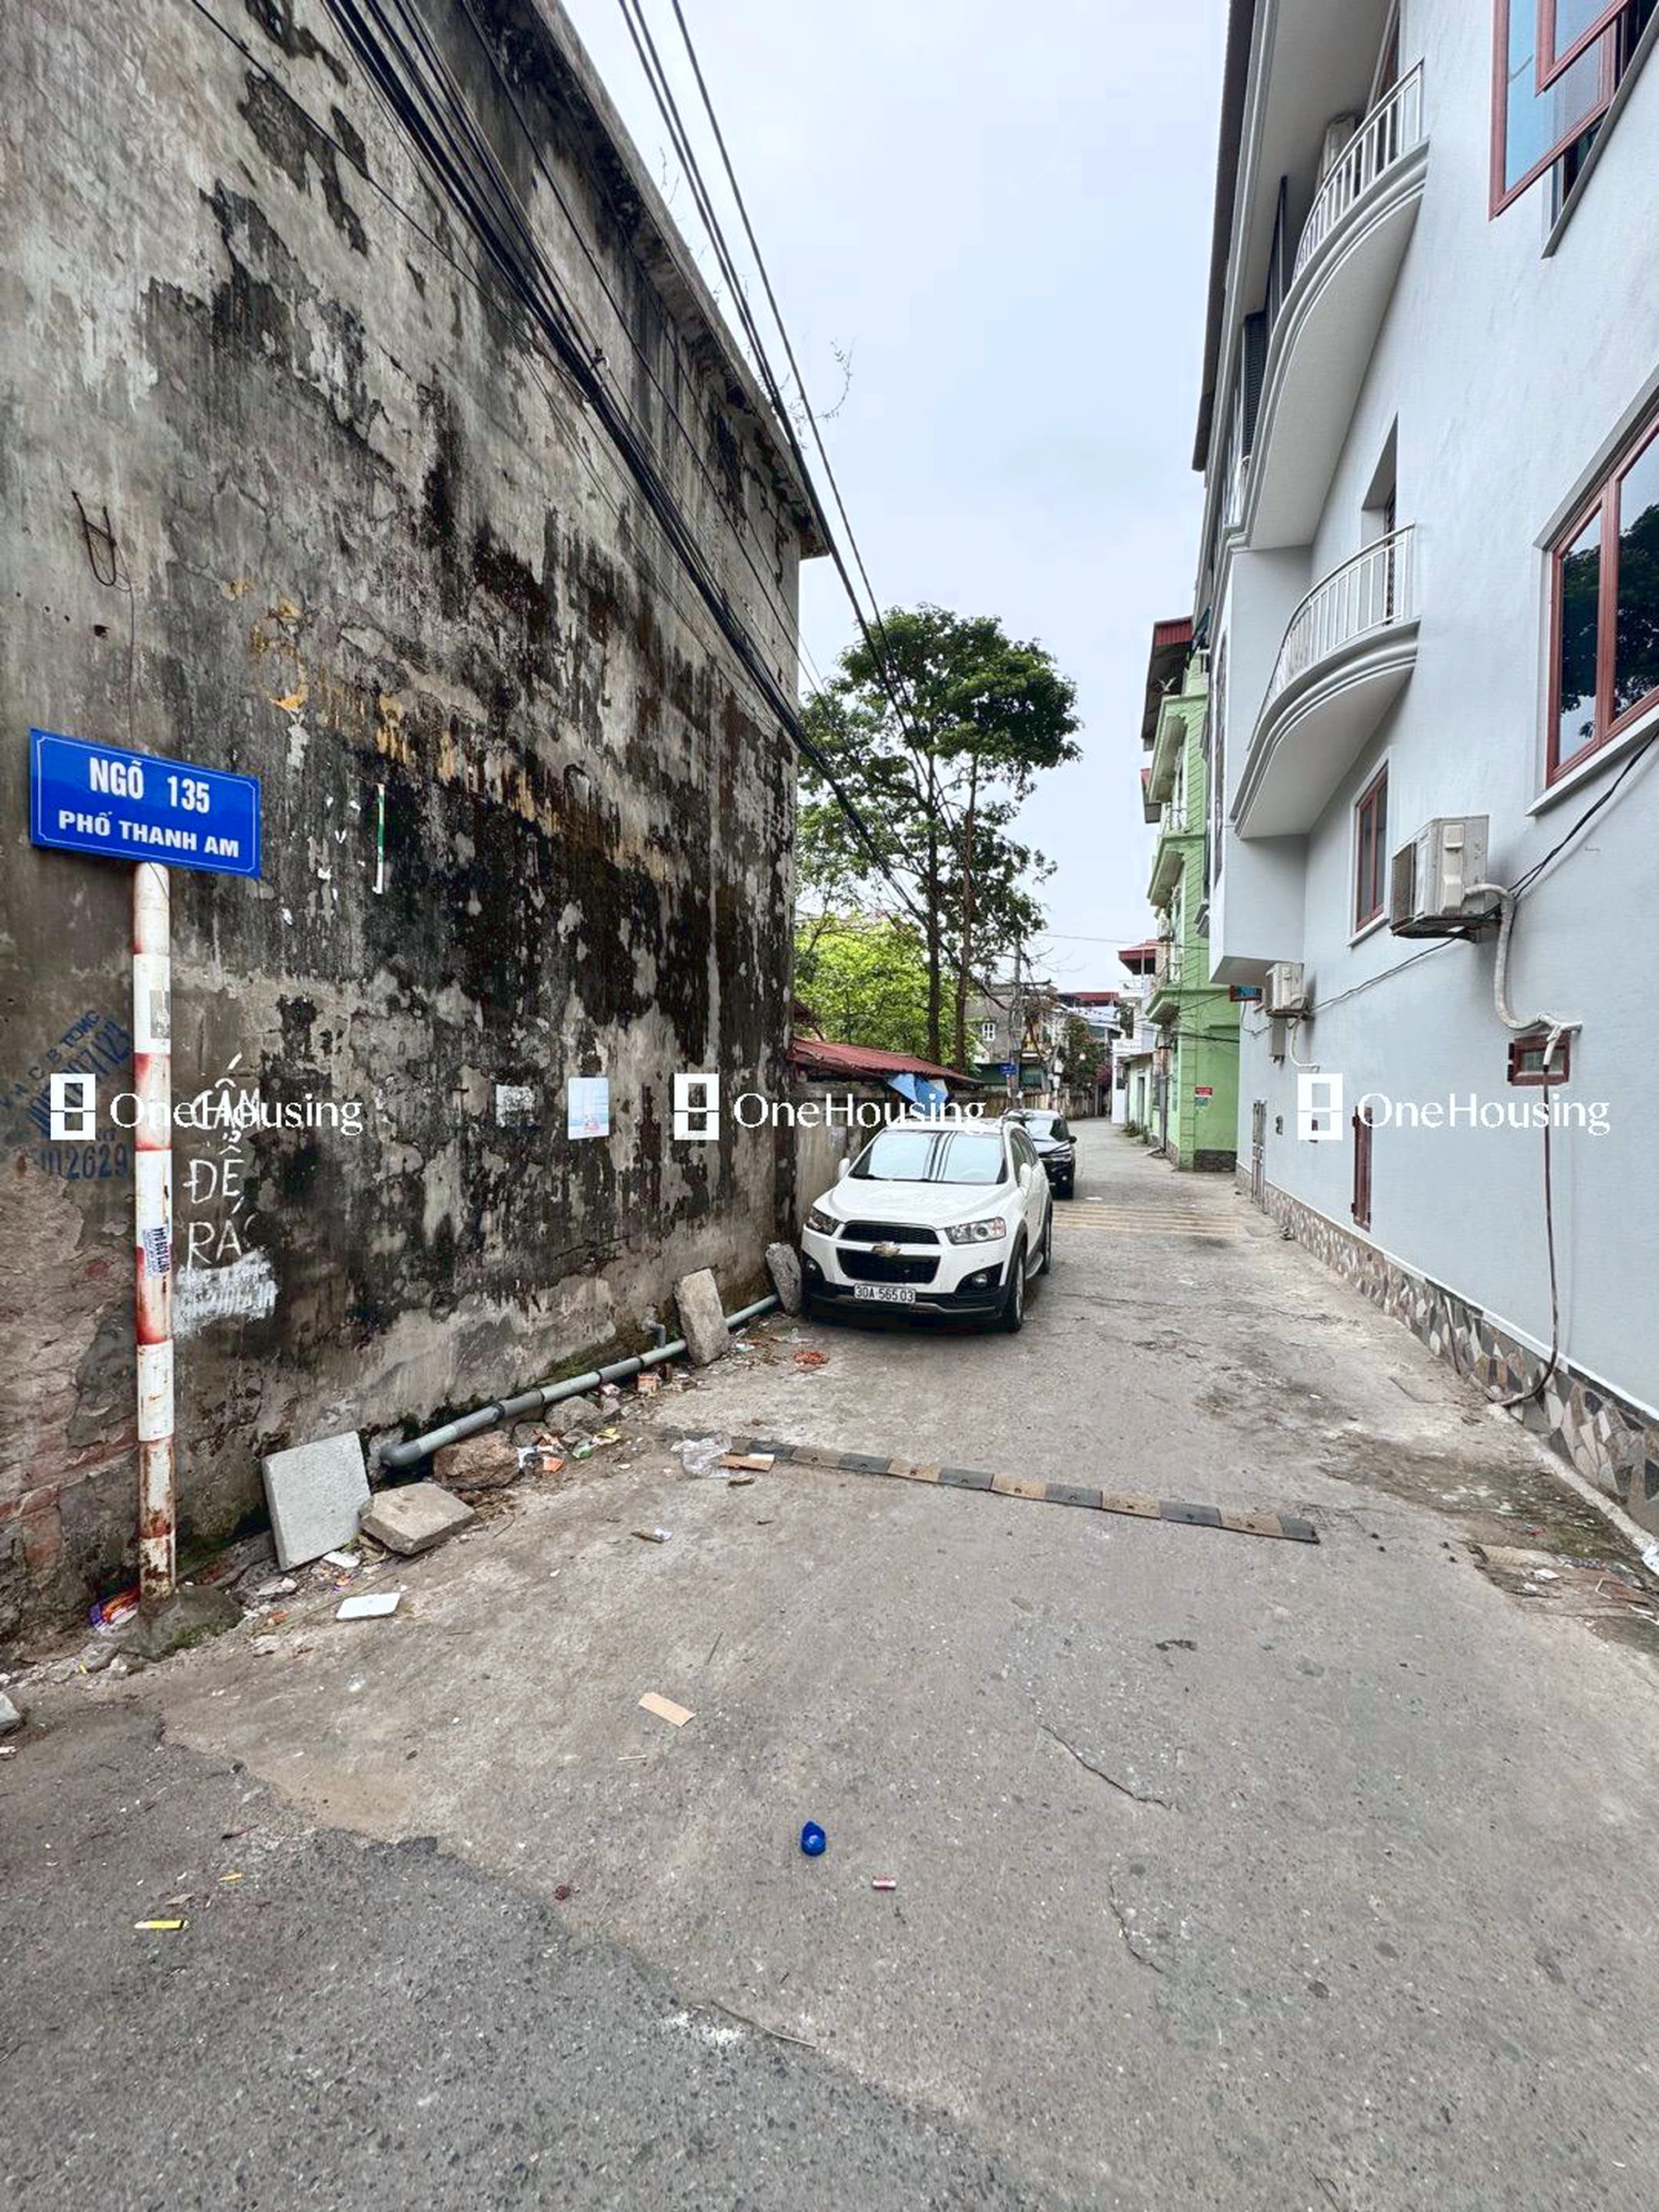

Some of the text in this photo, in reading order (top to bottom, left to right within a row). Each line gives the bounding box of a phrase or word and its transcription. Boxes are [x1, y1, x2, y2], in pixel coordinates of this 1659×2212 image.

[89, 757, 211, 814] NGÕ 135
[58, 810, 240, 858] PHỐ THANH AM
